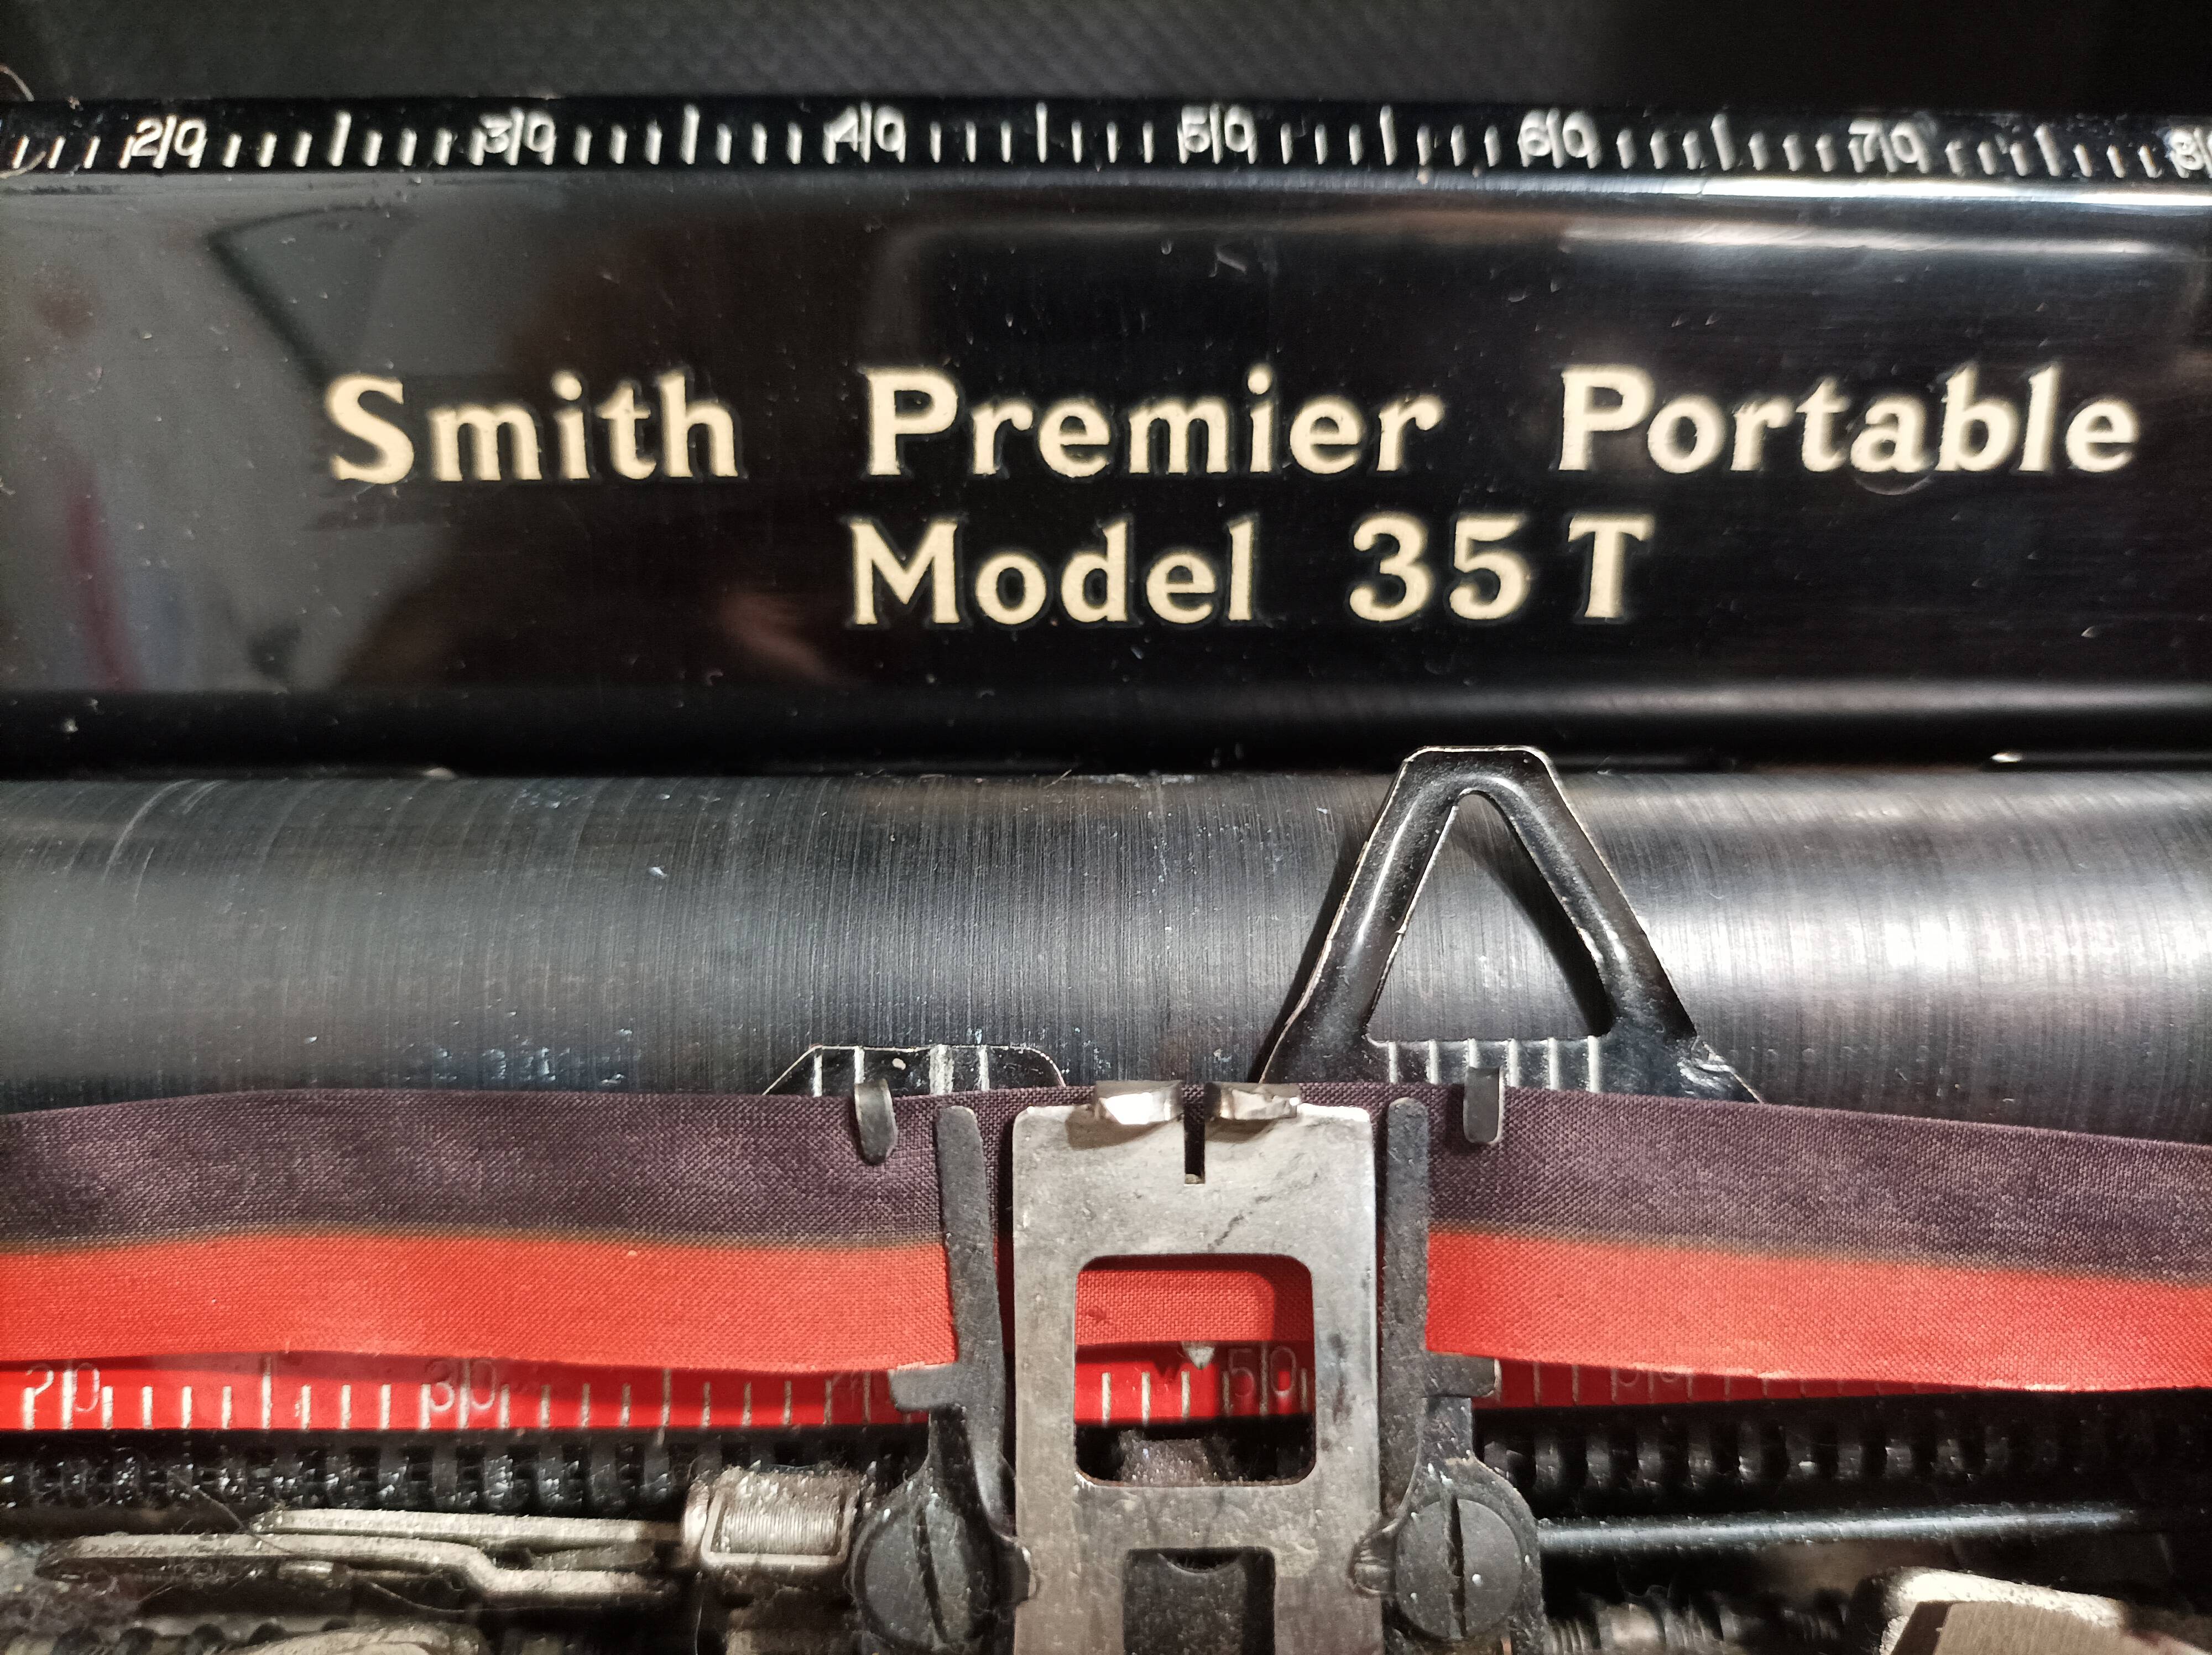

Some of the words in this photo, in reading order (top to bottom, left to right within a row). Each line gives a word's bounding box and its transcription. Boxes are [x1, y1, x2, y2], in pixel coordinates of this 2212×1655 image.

[131, 113, 207, 158] 20
[478, 112, 556, 154] 30
[824, 105, 905, 153] 40
[1182, 105, 1254, 153] 50
[1520, 109, 1597, 159] 60
[1848, 118, 1927, 164] 70
[2163, 127, 2212, 171] 8
[326, 369, 740, 485] Smith
[860, 362, 1446, 478] Premier
[1557, 360, 2141, 475] Portable
[848, 513, 1256, 626] Model
